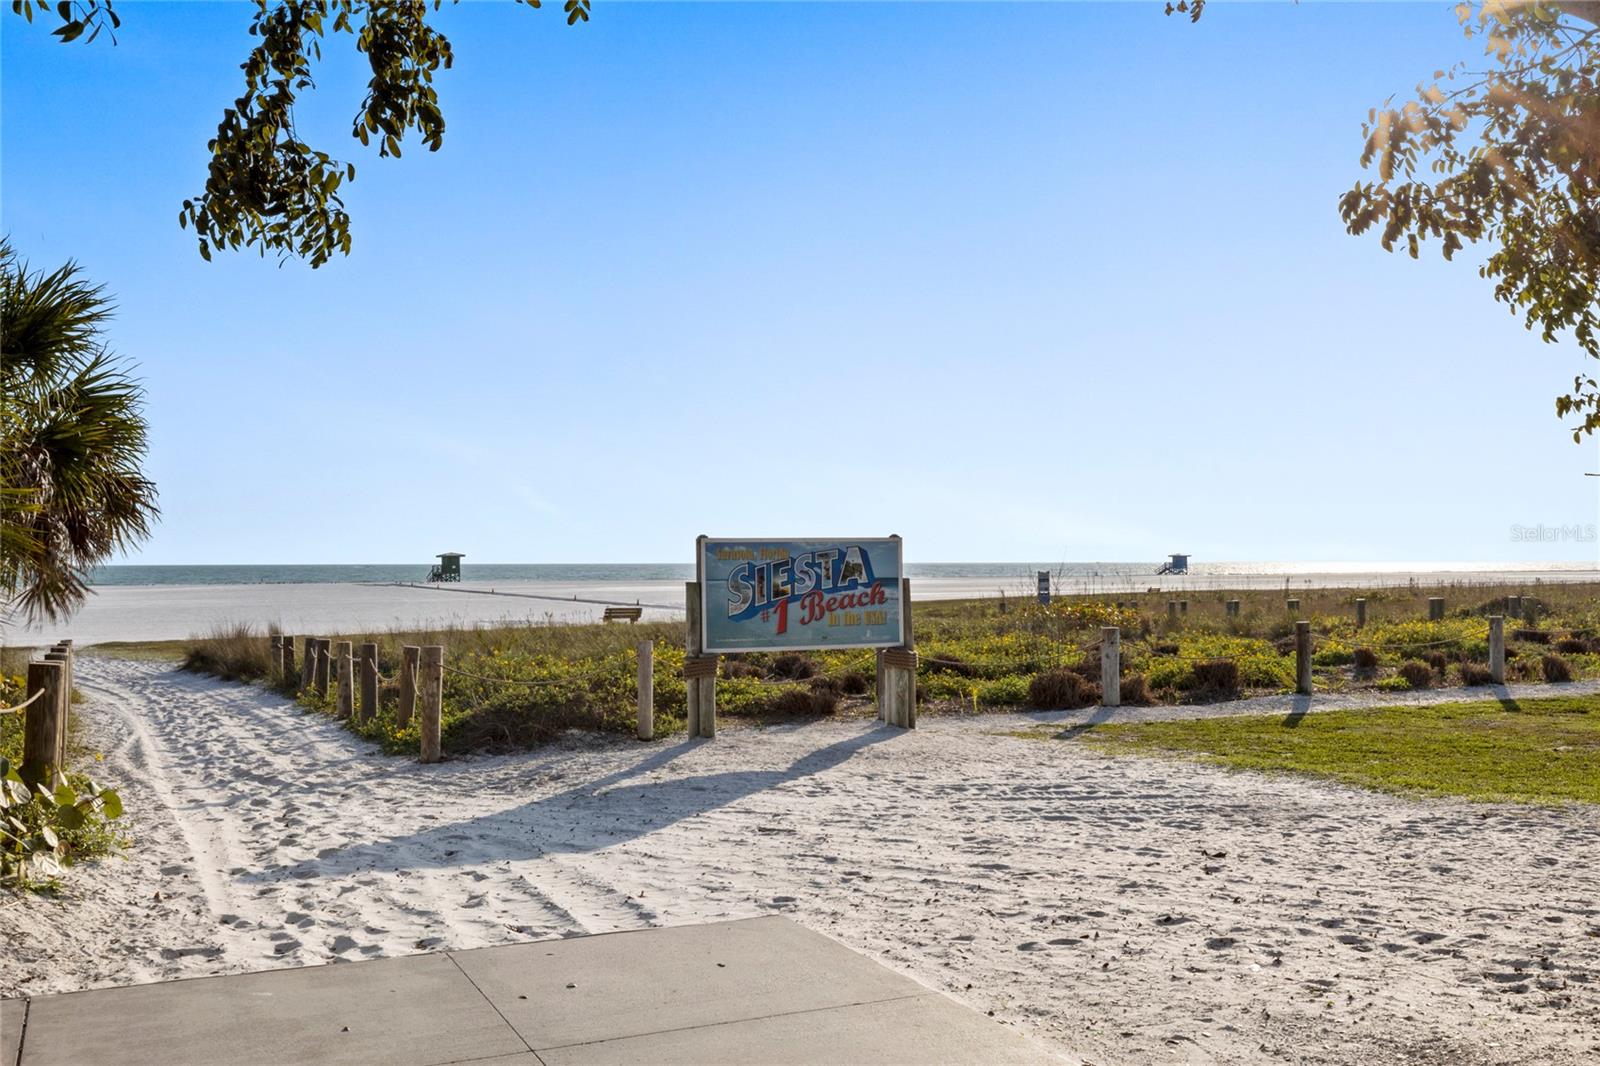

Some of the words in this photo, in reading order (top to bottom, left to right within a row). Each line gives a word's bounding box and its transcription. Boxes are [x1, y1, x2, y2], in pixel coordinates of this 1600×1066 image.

[728, 546, 872, 620] SIESTA
[760, 598, 789, 635] #1
[799, 581, 888, 625] Beach
[828, 612, 842, 626] in
[843, 611, 861, 625] the
